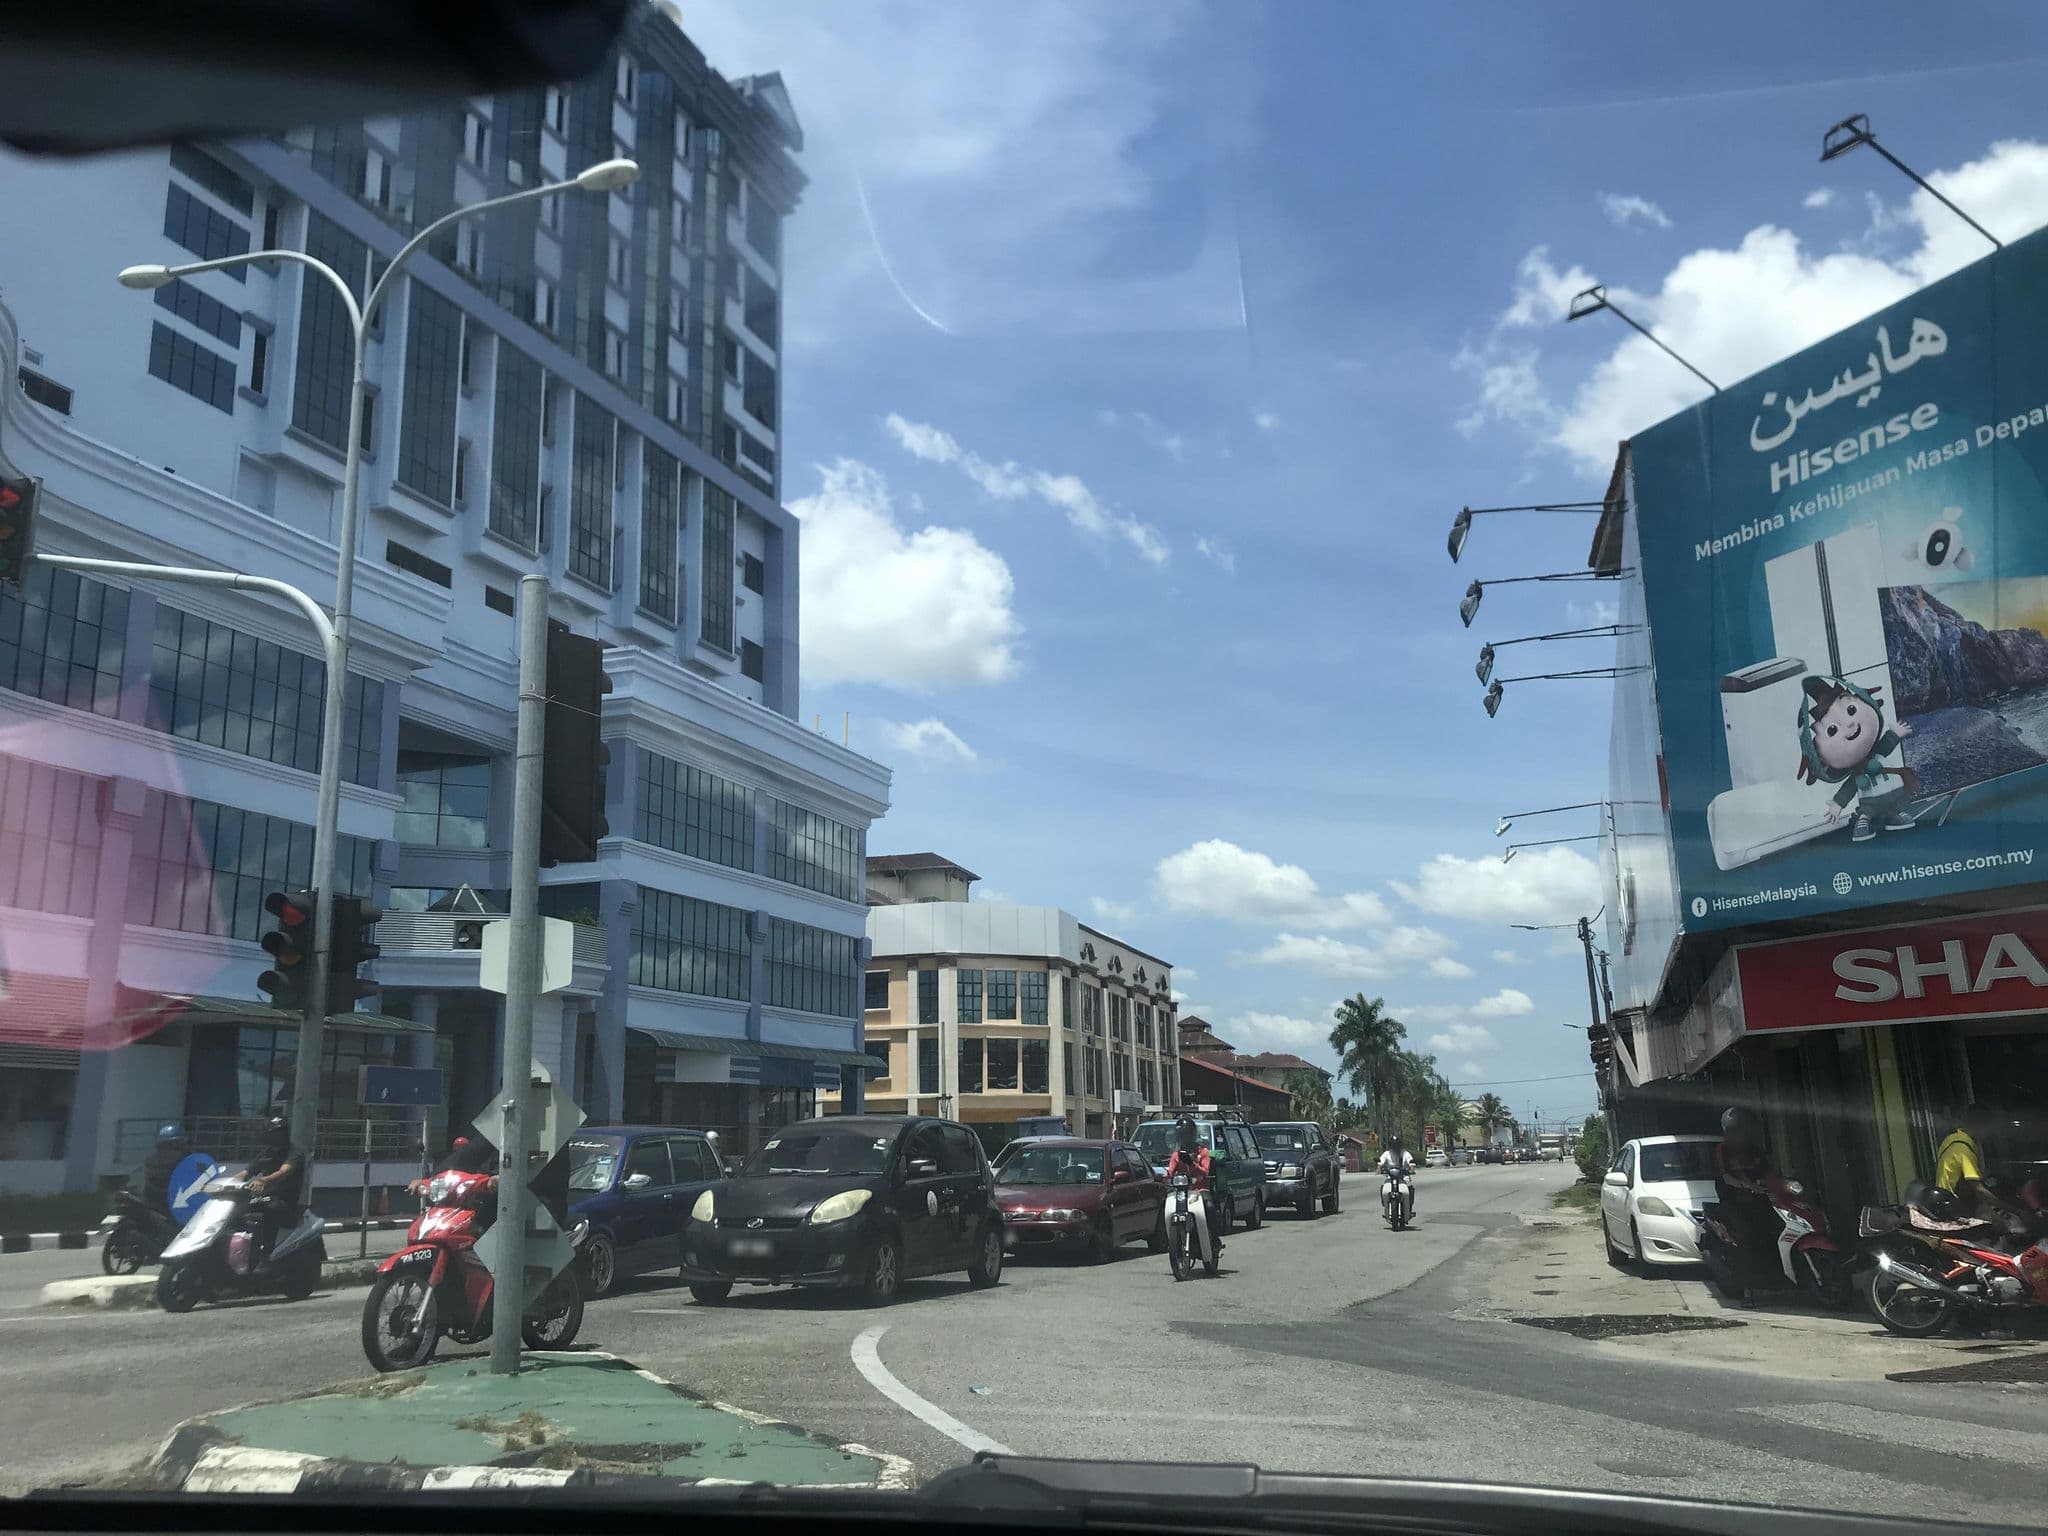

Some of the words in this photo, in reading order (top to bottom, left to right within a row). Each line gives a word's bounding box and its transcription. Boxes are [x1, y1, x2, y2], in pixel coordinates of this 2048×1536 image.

[1750, 317, 1948, 452] هايسن
[1695, 511, 1785, 561] Membina
[1789, 466, 1900, 524] Kehijauan
[1906, 437, 1970, 476] Masa
[1976, 403, 2048, 448] Depa
[1770, 402, 1939, 493] Hisense
[1712, 883, 1817, 912] HisenseMalaysia
[1858, 847, 2035, 887] www.hisense.com.my
[1832, 932, 2048, 1003] SHA
